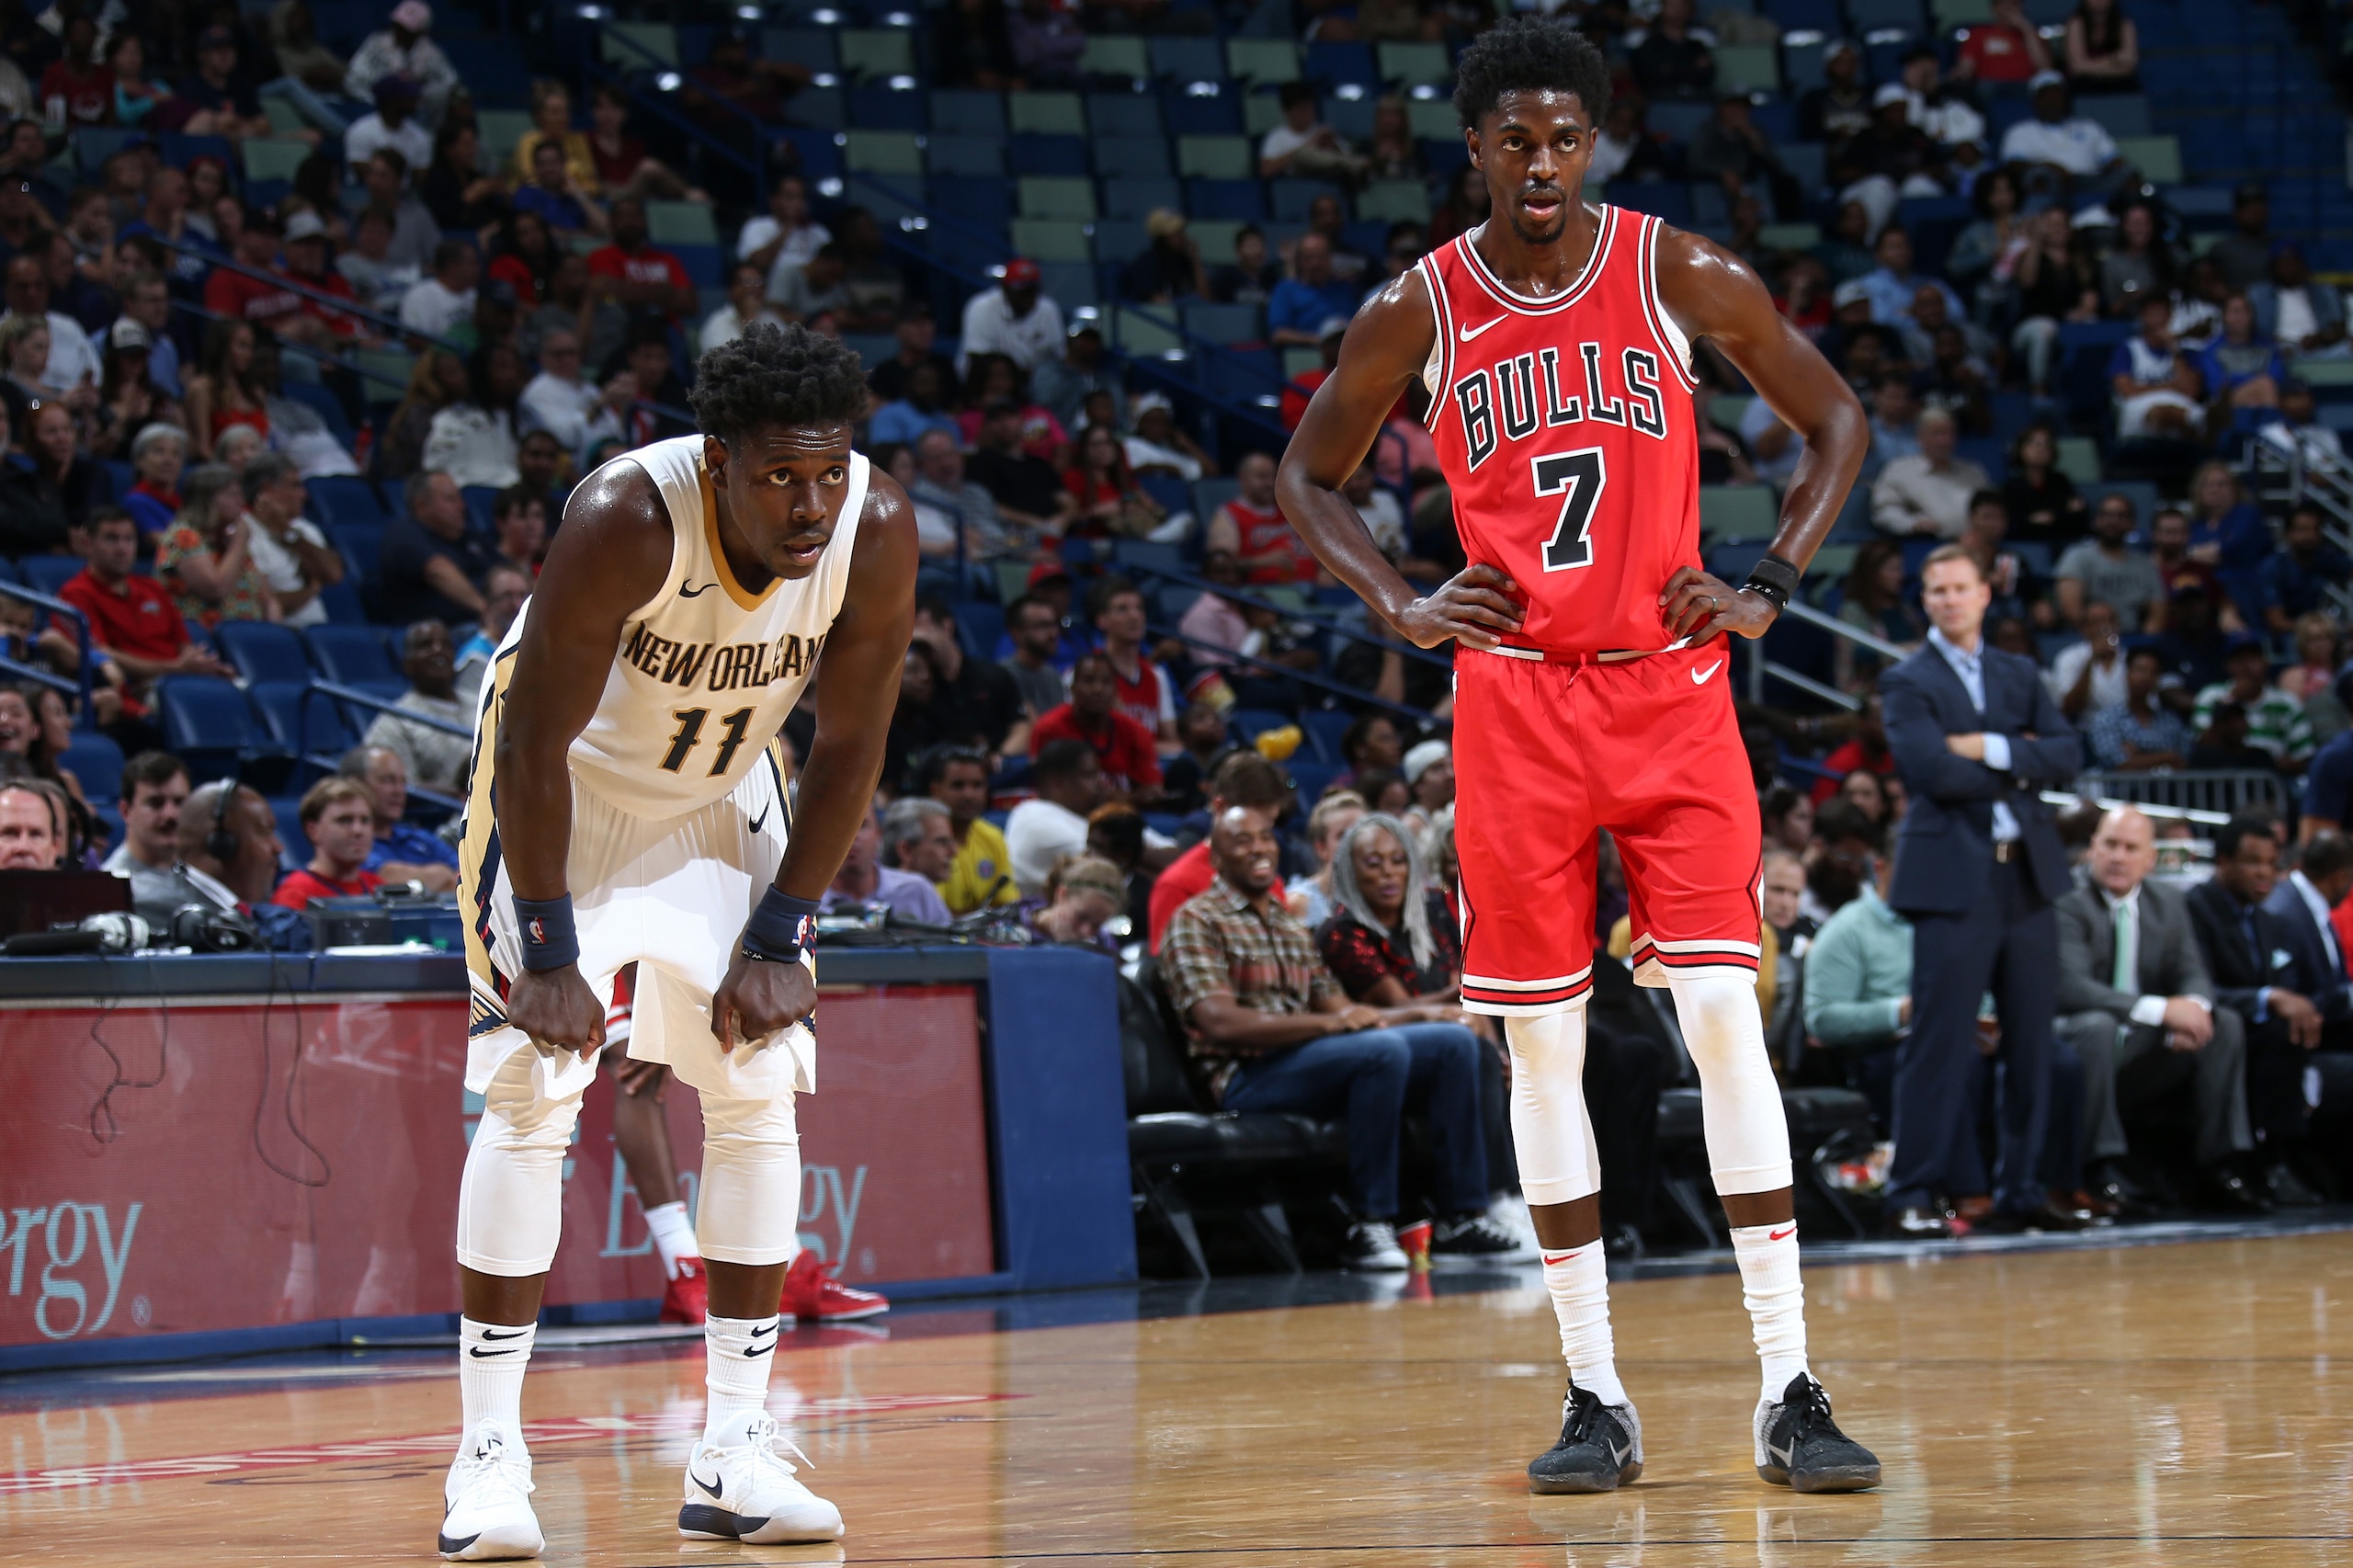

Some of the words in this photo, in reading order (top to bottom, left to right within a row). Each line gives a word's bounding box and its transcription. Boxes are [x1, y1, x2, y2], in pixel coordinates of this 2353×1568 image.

[1453, 341, 1667, 473] BULLS
[1529, 446, 1607, 573] 7
[621, 619, 716, 687] NEW
[656, 706, 757, 778] 11
[0, 1199, 143, 1340] rgy
